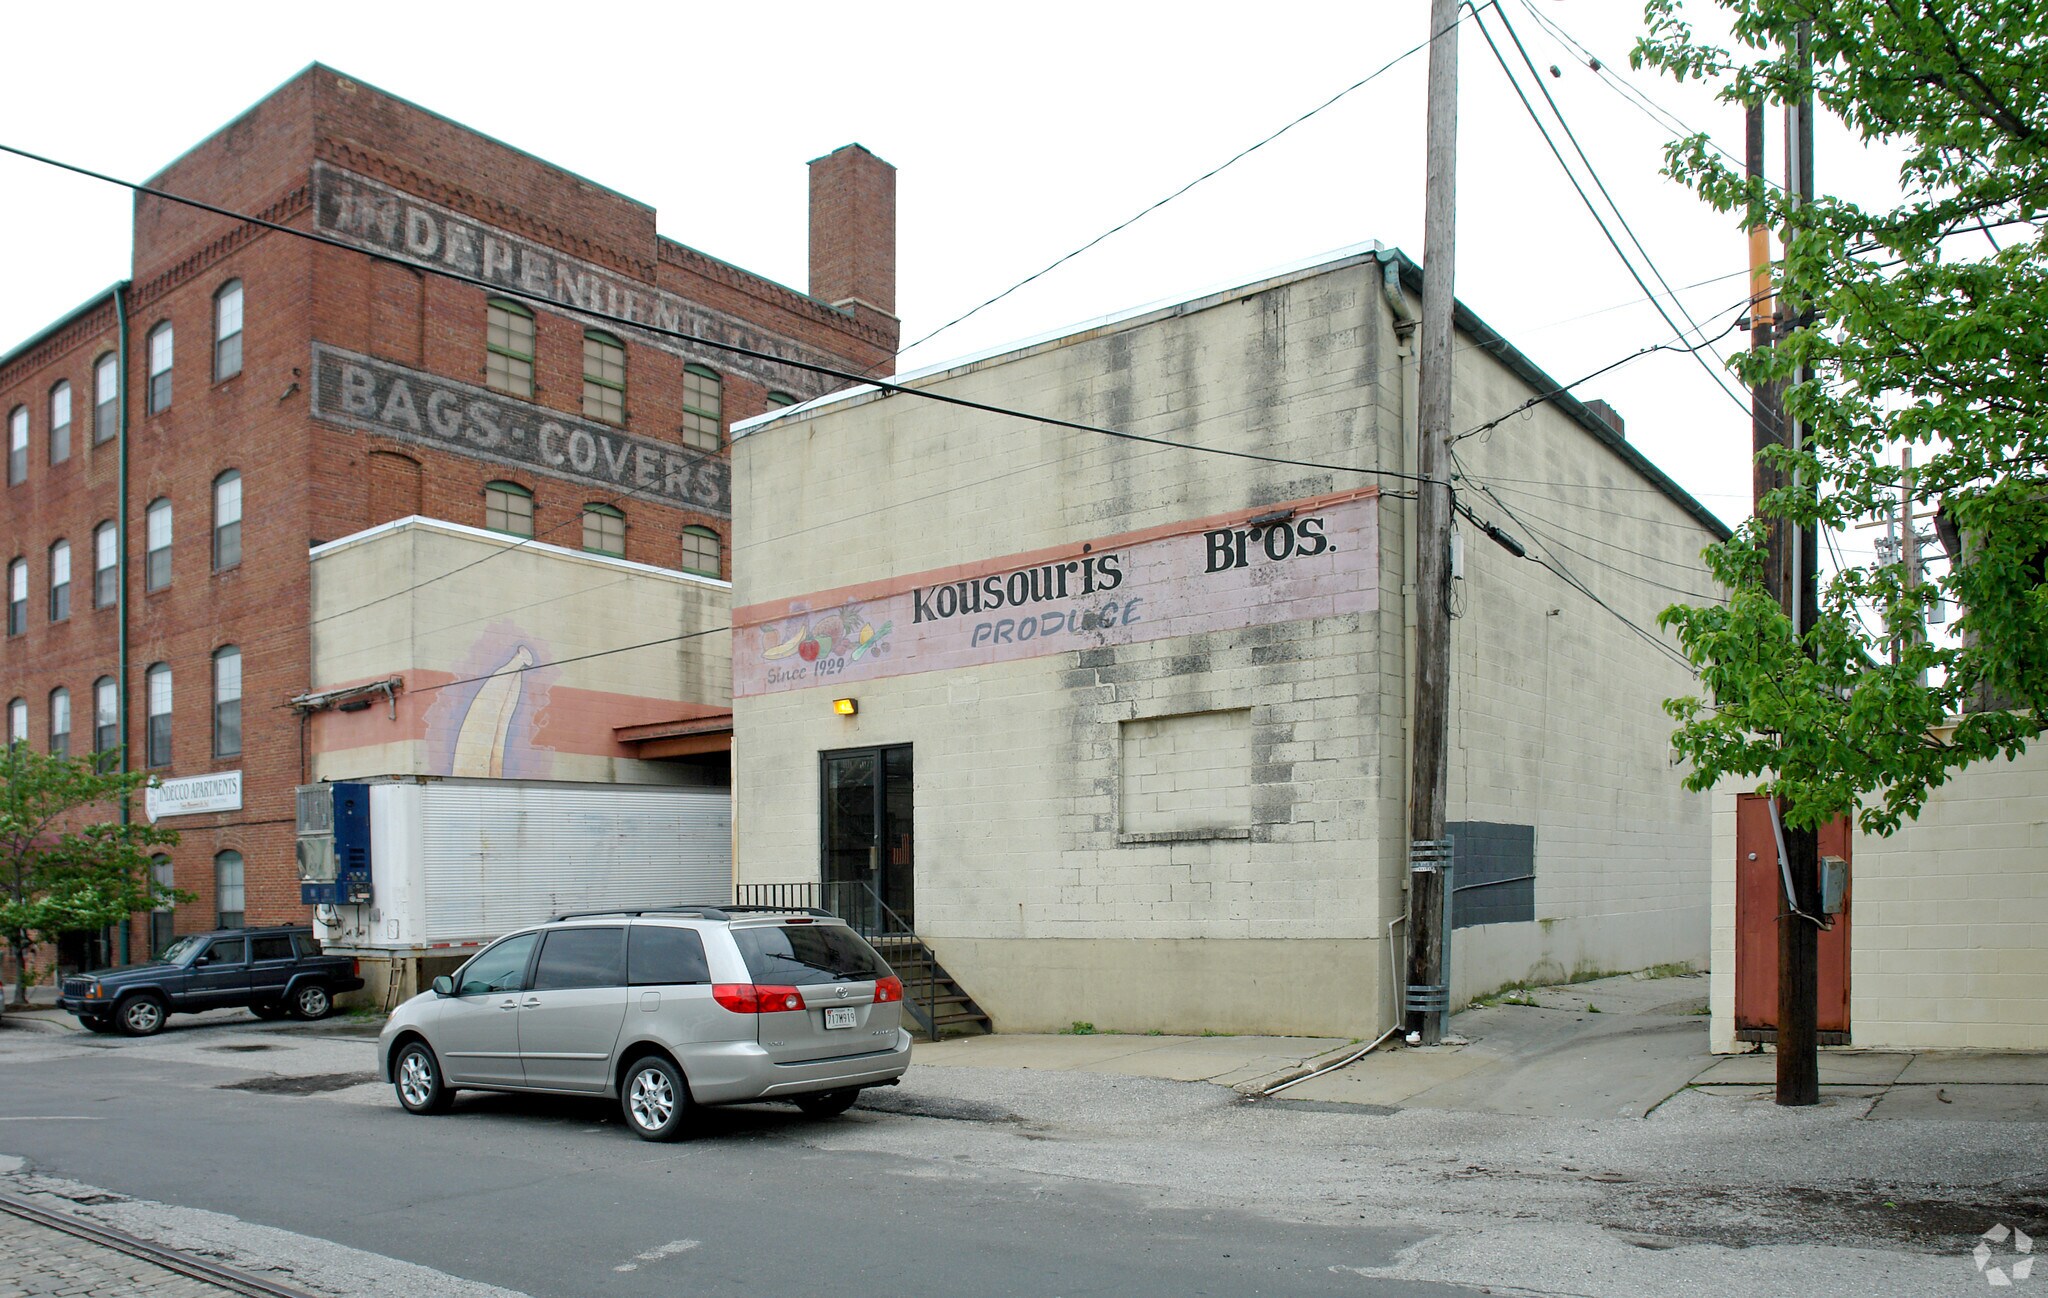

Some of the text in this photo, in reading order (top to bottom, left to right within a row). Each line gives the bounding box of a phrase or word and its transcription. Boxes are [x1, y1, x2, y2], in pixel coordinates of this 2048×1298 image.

[342, 363, 720, 504] BAGS COVERS
[1203, 517, 1337, 574] Bros.
[971, 597, 1143, 648] PRODUCE
[767, 657, 845, 685] Since 1929
[159, 783, 190, 803] INDECCO
[190, 777, 238, 799] APARTMENTS
